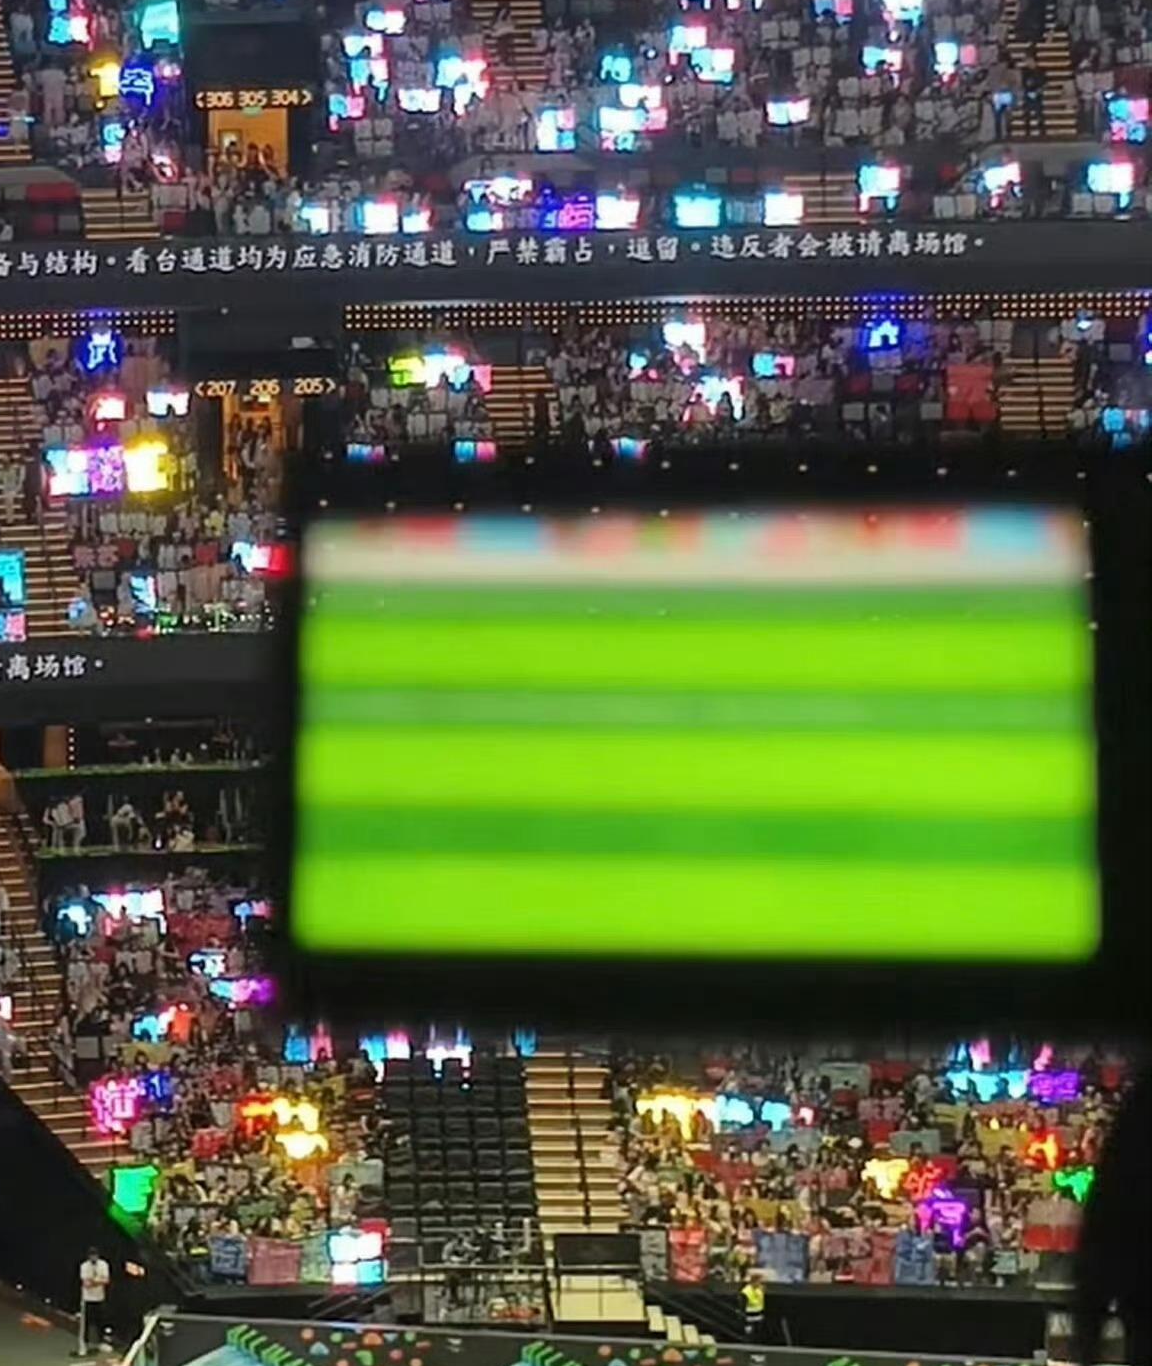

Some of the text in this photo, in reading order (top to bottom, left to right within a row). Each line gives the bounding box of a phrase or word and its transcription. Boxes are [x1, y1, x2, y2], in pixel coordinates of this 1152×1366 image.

[206, 88, 298, 108] 306 305 304
[207, 377, 324, 396] 207 206 205
